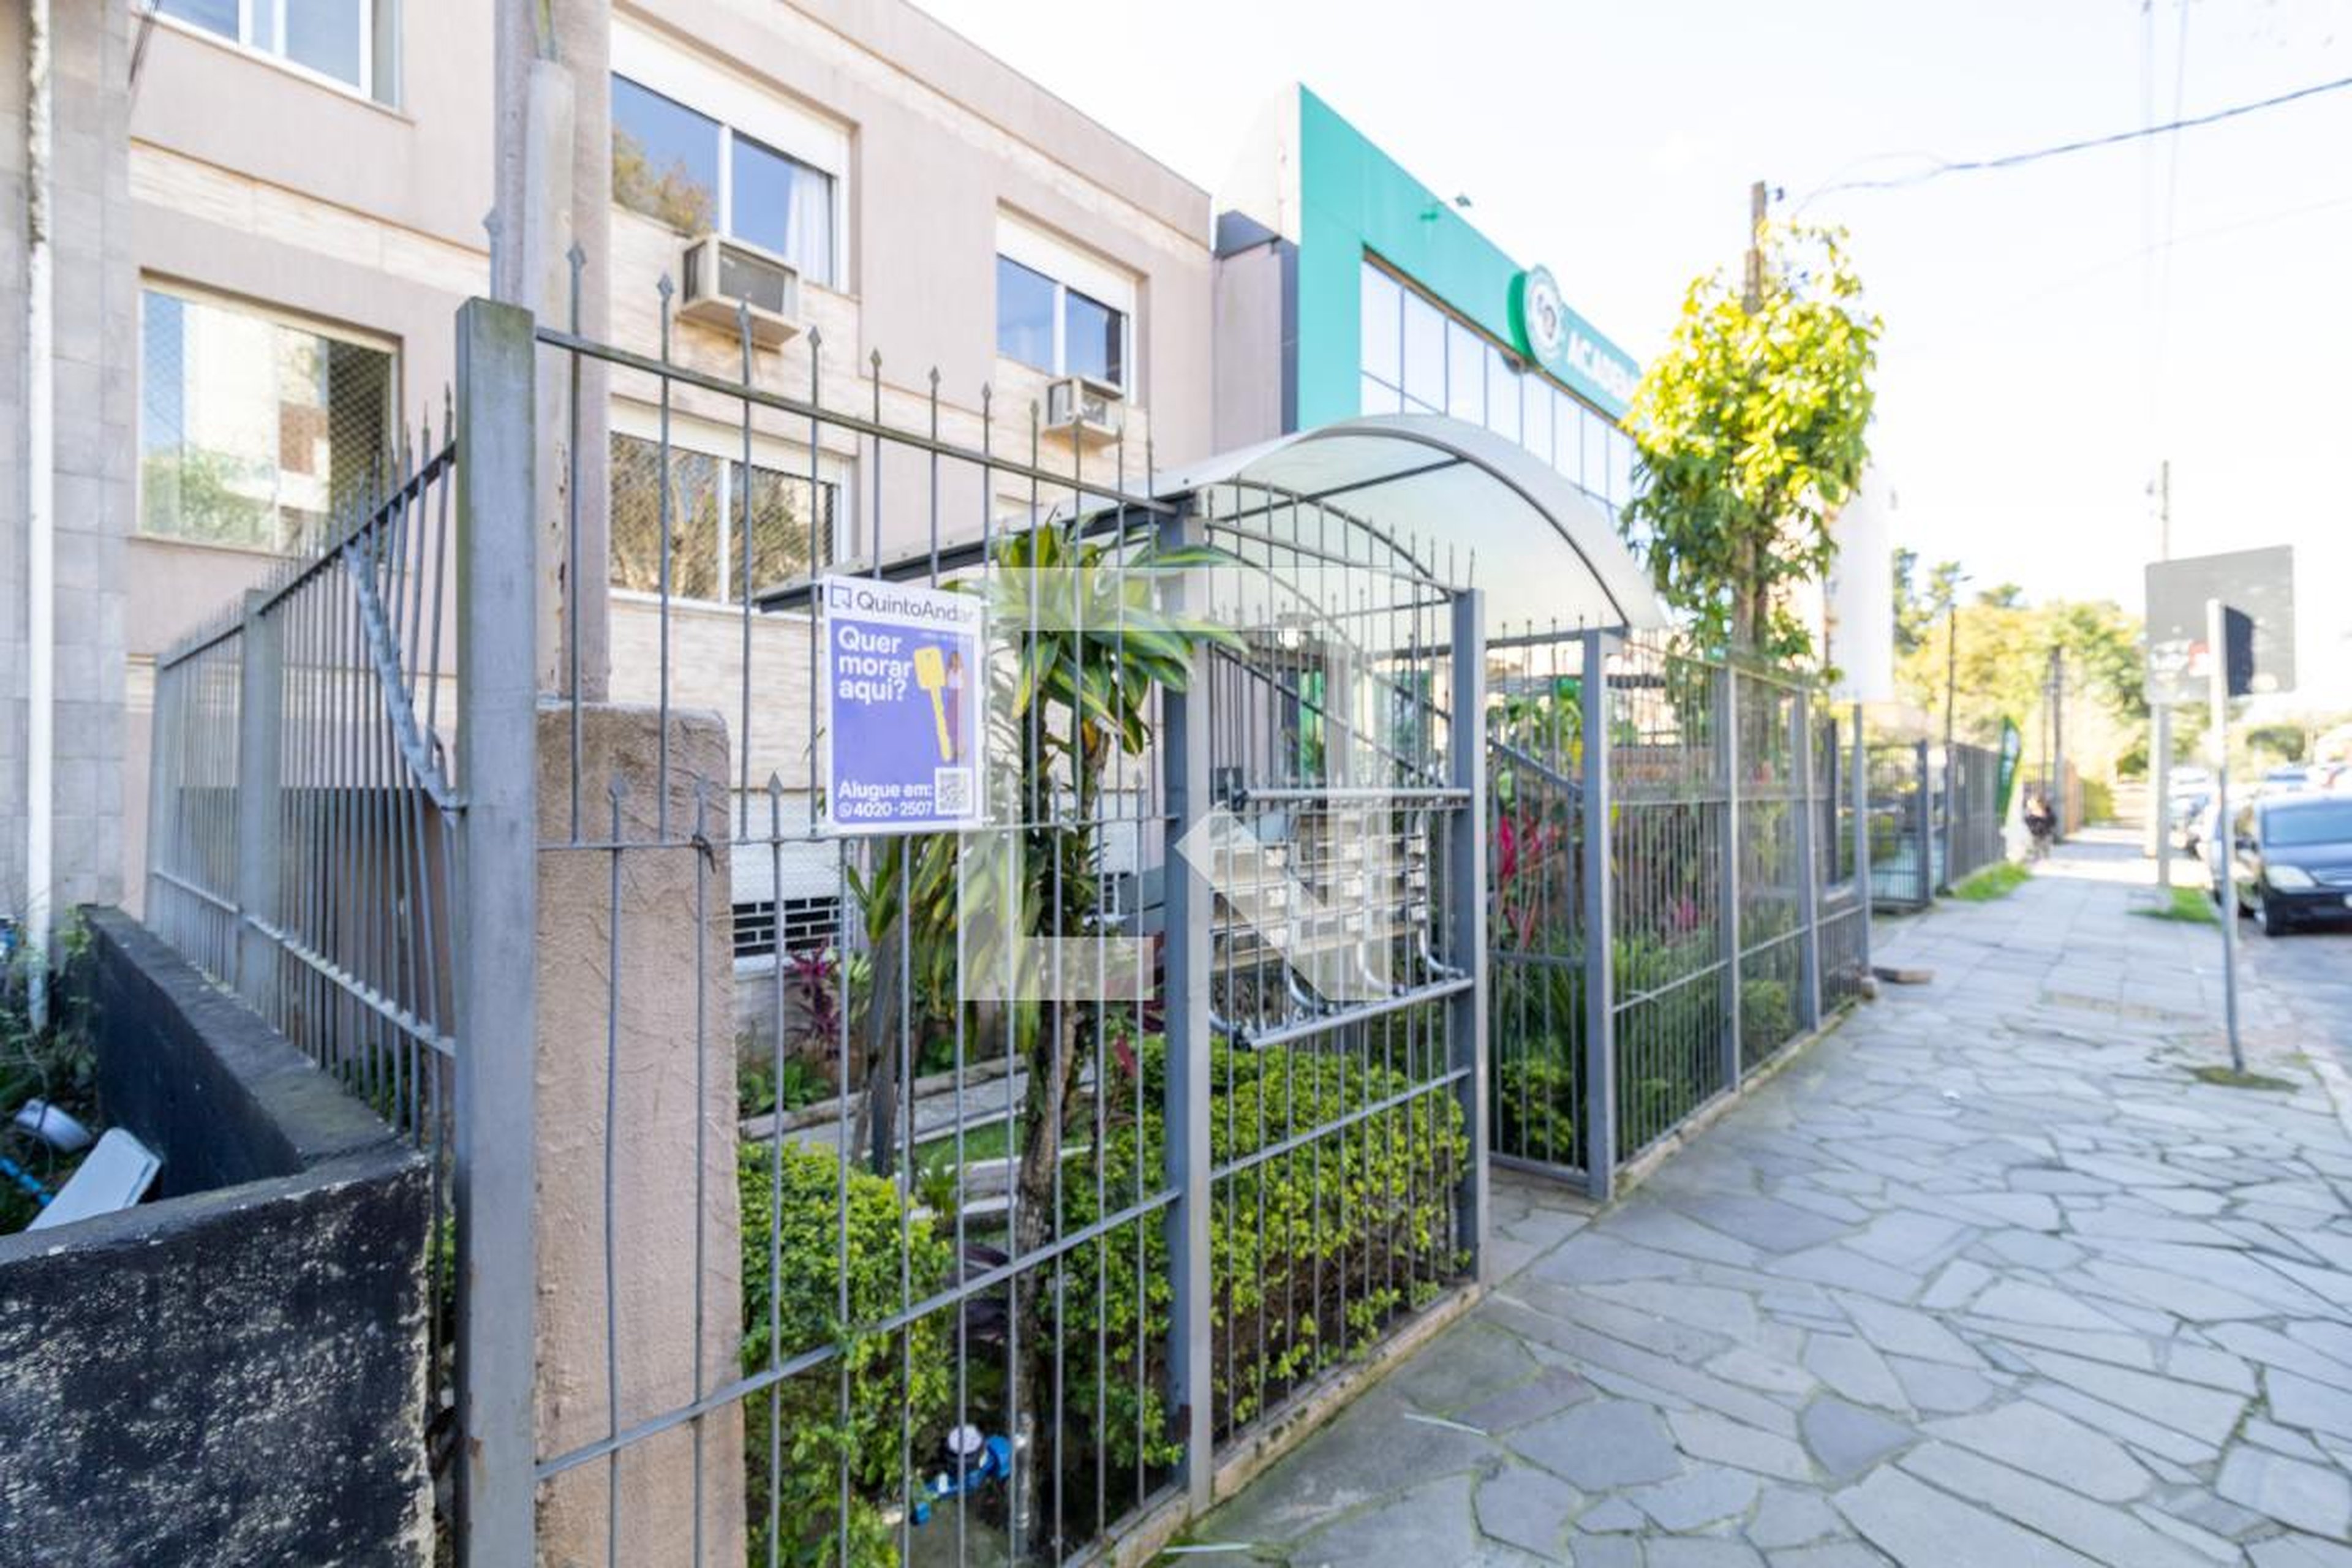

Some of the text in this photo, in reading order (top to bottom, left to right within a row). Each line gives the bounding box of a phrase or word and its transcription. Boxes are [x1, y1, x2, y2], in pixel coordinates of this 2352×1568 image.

[839, 626, 902, 654] Quer
[839, 655, 912, 678] morar
[839, 679, 907, 704] aqui?
[839, 781, 932, 800] Alugue em:
